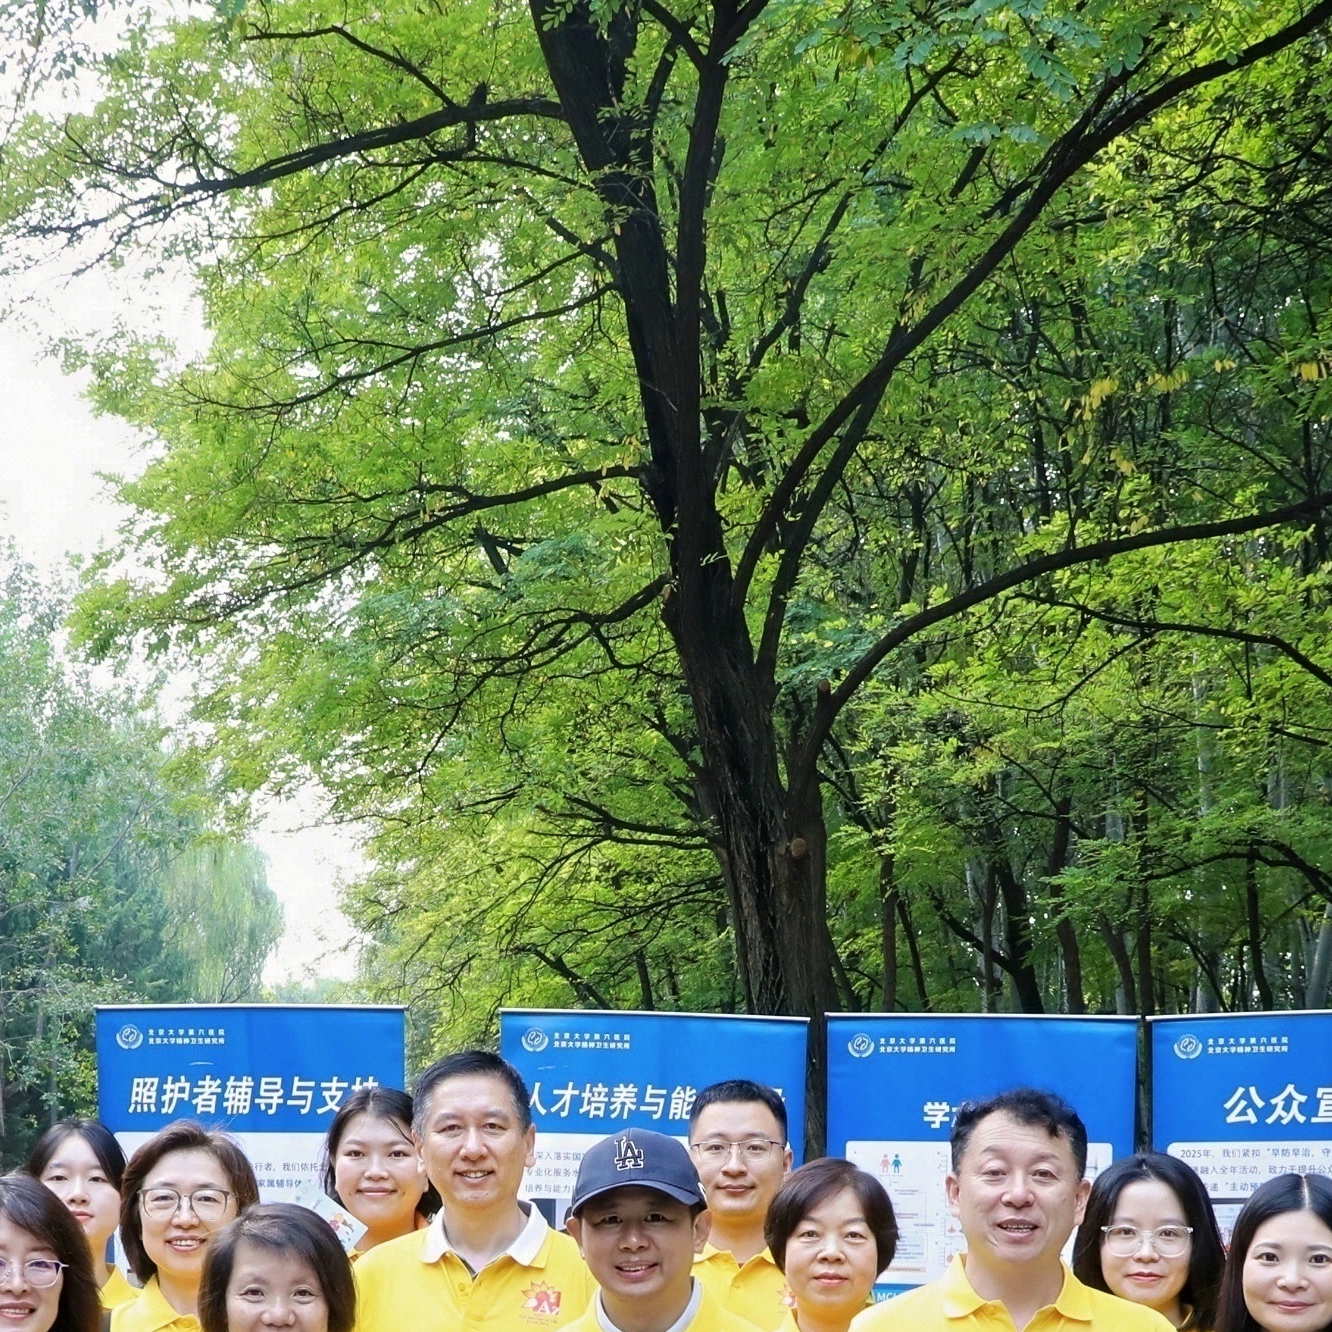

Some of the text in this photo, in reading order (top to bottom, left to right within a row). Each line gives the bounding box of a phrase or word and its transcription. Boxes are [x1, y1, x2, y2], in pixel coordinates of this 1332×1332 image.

[923, 1101, 965, 1129] 学
[535, 1151, 585, 1162] 深入落实国
[613, 1135, 644, 1171] LA
[524, 1183, 575, 1194] 培养与能力
